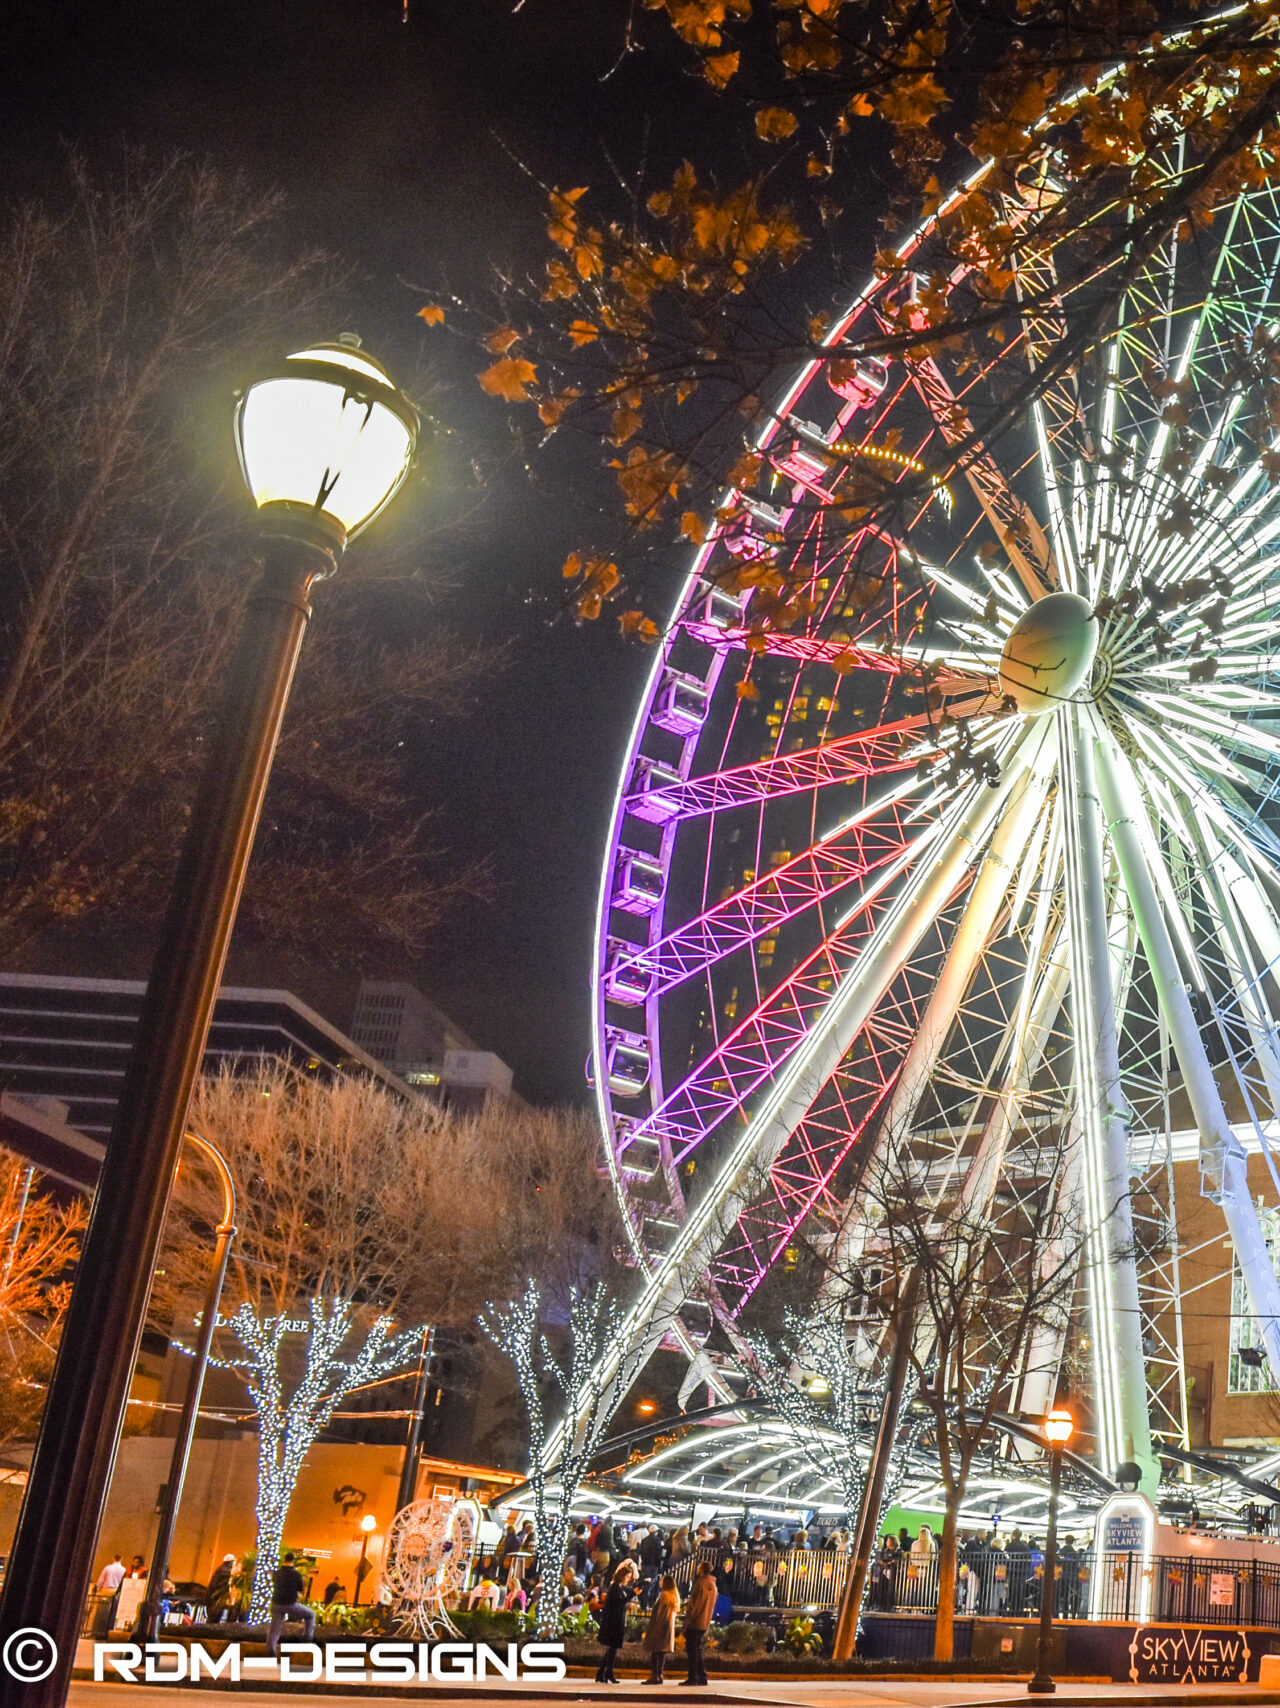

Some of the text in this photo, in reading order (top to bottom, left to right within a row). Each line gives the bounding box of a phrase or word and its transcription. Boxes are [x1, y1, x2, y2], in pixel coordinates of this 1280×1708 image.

[1106, 1529, 1143, 1538] SKYVIEW
[1106, 1537, 1143, 1546] ATLANTA
[1142, 1629, 1239, 1662] SKYVIEW
[1149, 1663, 1231, 1684] ATLANTA
